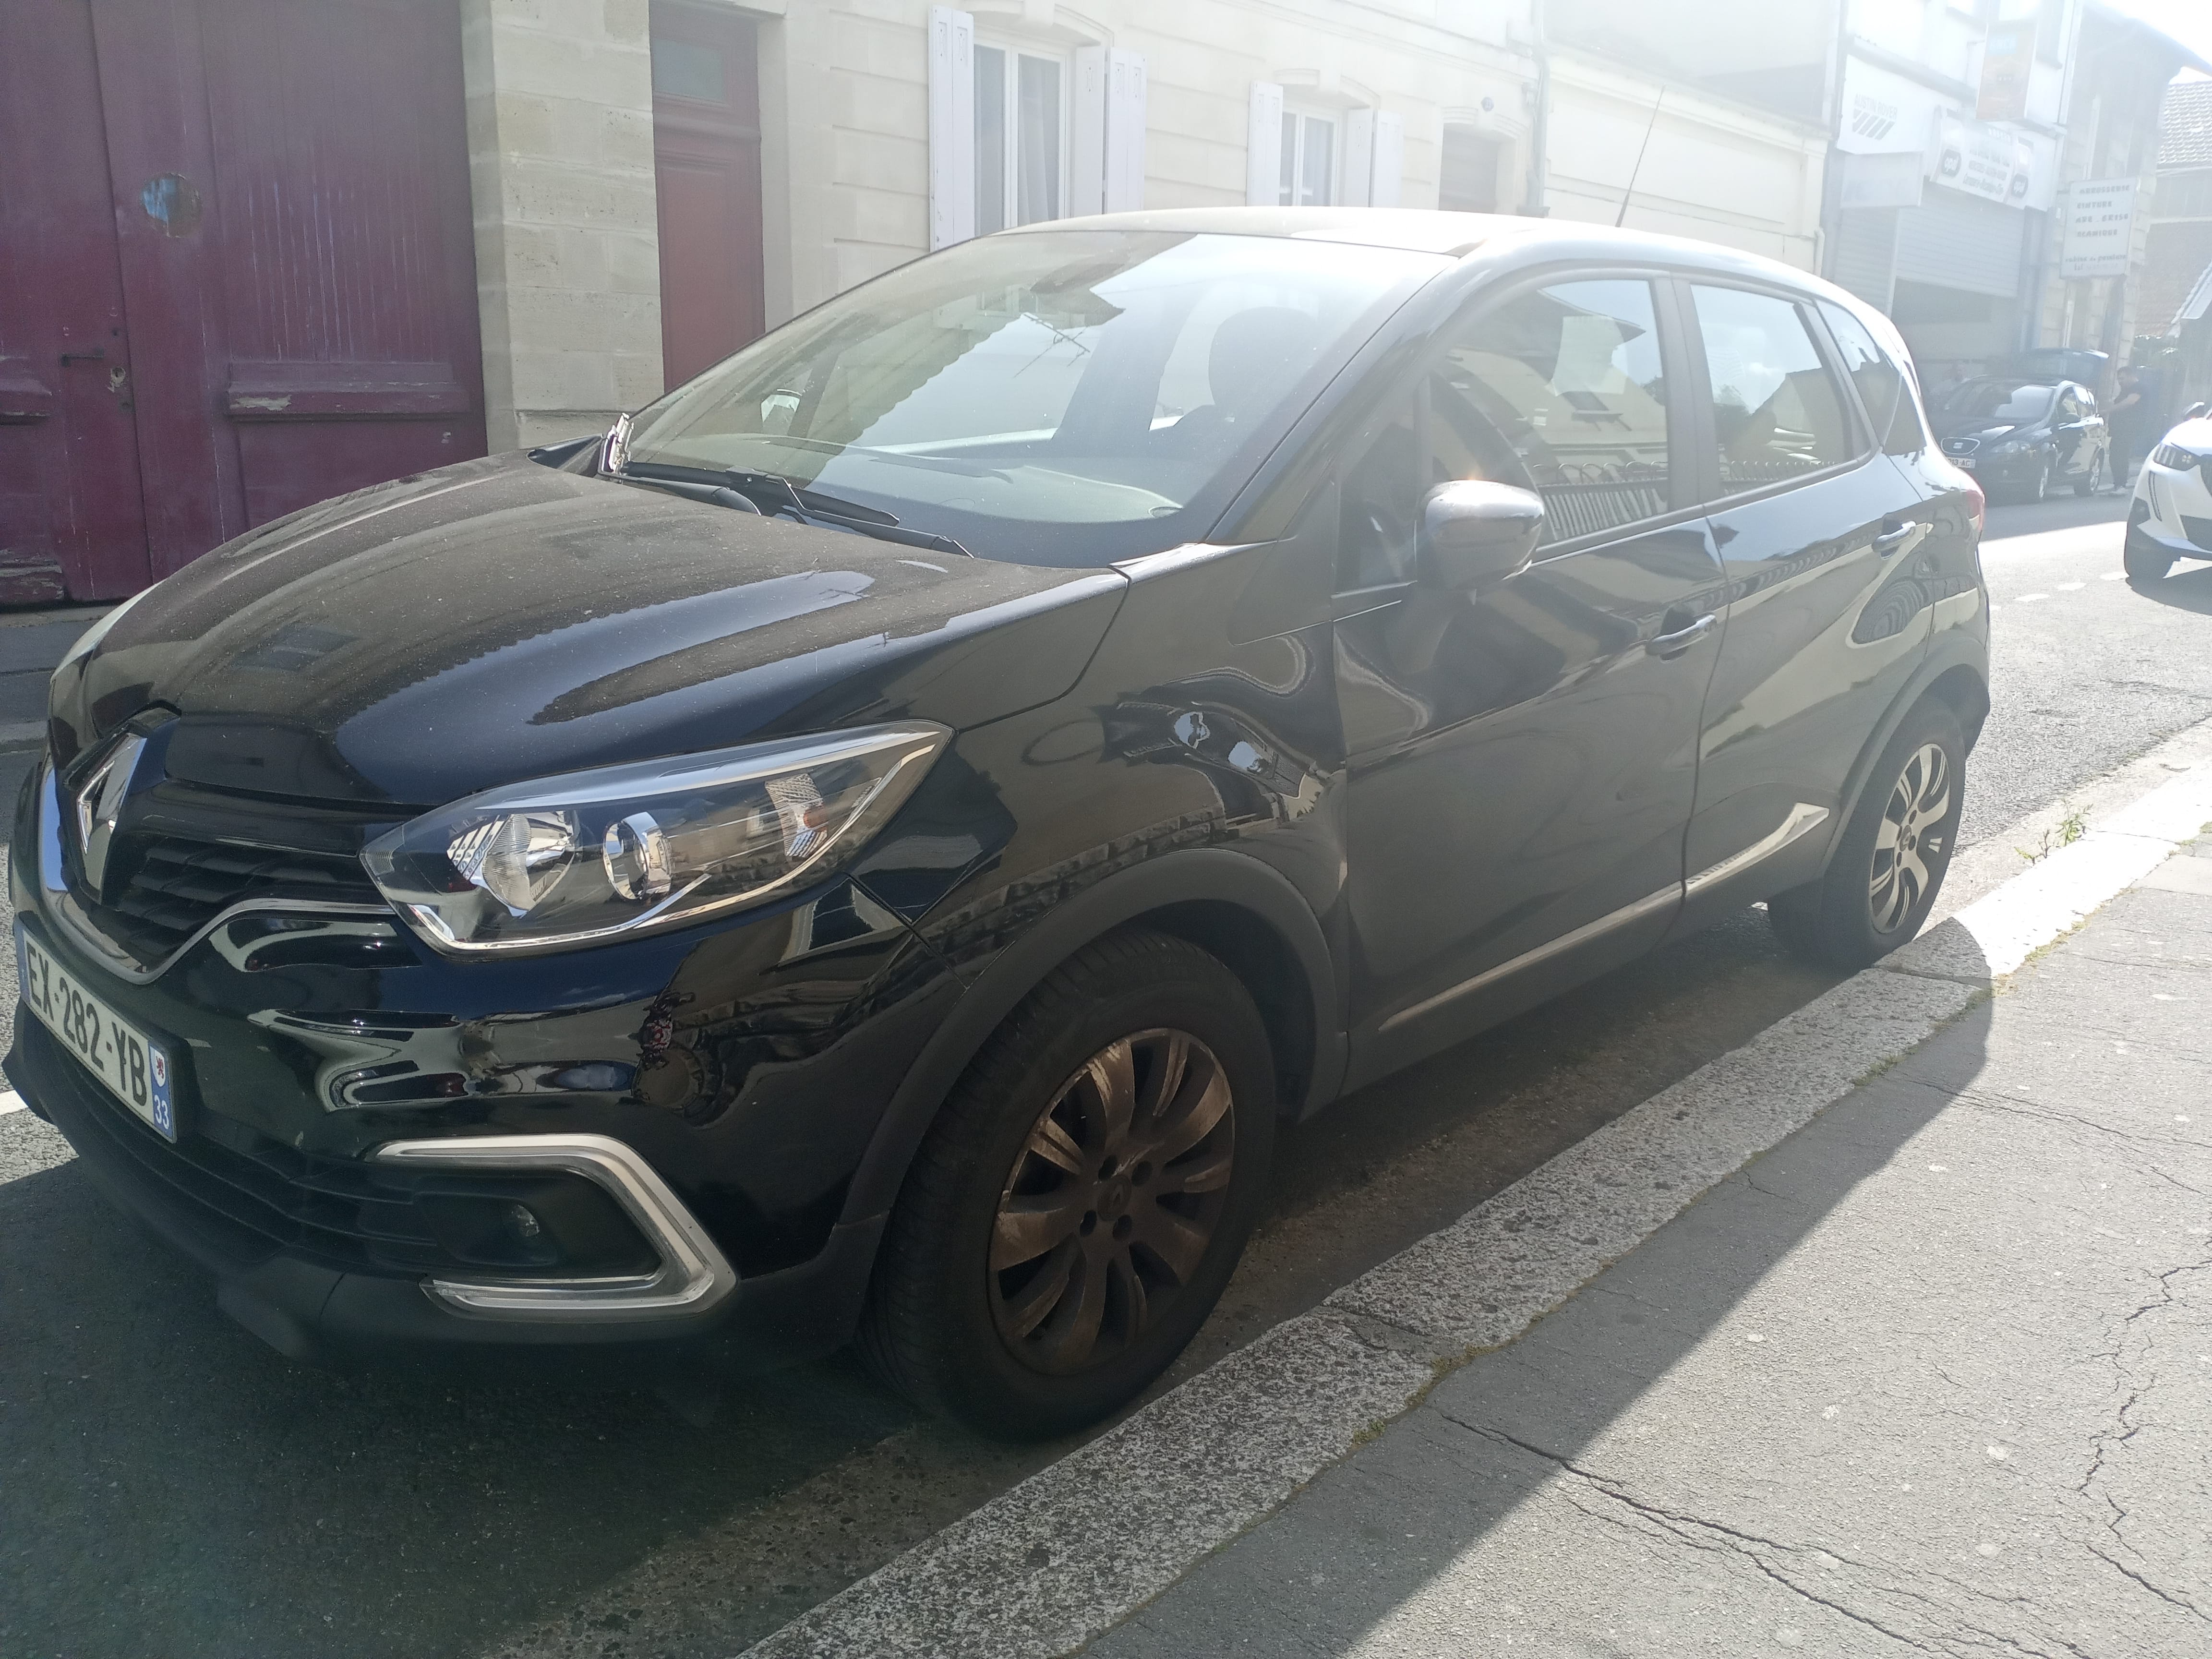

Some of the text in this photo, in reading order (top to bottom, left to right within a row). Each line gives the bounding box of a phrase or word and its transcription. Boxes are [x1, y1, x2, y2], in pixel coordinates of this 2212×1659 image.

[1854, 92, 1898, 119] AUSTIN ROVER
[26, 941, 147, 1106] EX-282-YB
[154, 1095, 169, 1130] 33
